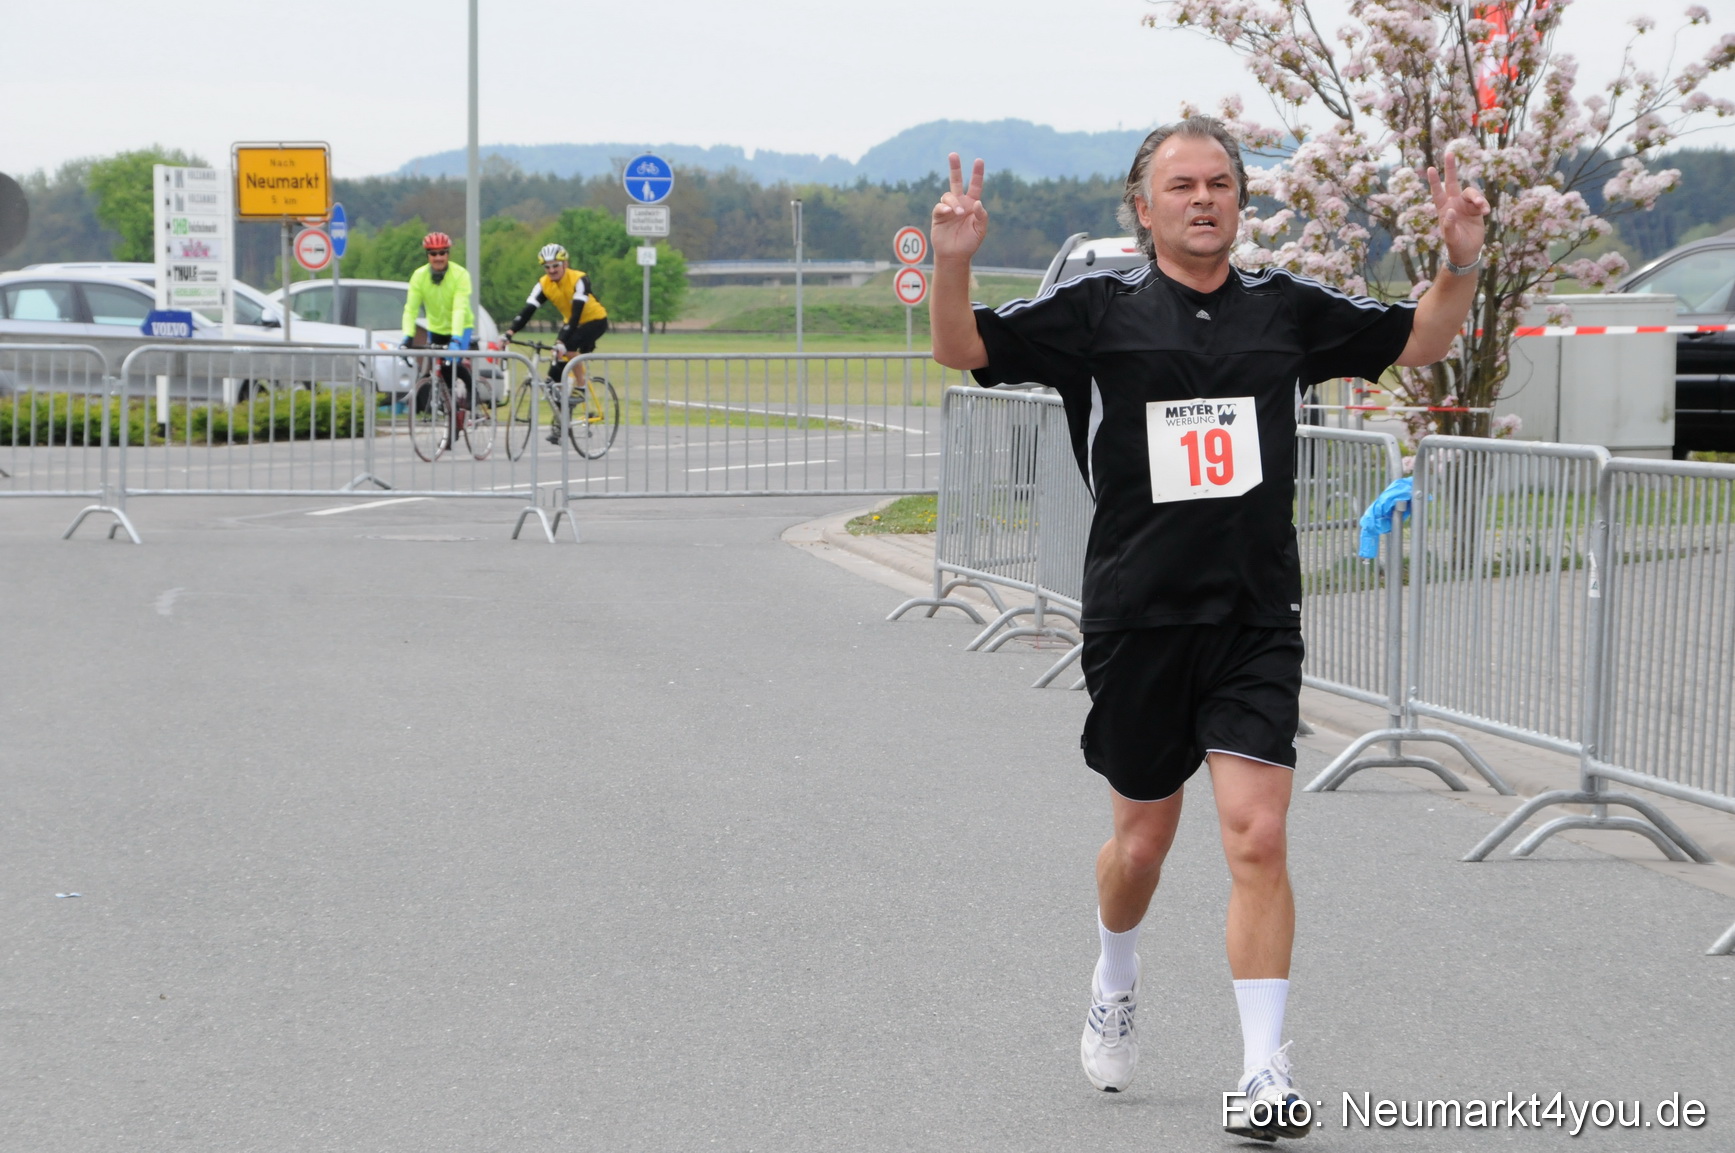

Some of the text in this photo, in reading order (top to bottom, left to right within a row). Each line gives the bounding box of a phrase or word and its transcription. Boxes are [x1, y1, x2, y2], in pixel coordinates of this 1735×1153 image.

[270, 159, 295, 168] Nach
[246, 173, 319, 189] Neumarkt
[284, 196, 297, 205] km
[902, 238, 920, 254] 60
[173, 265, 198, 281] THULE
[150, 321, 190, 336] VOLVO
[1165, 404, 1214, 418] MEYER
[1166, 416, 1216, 427] WERBUNG
[1180, 428, 1234, 486] 19
